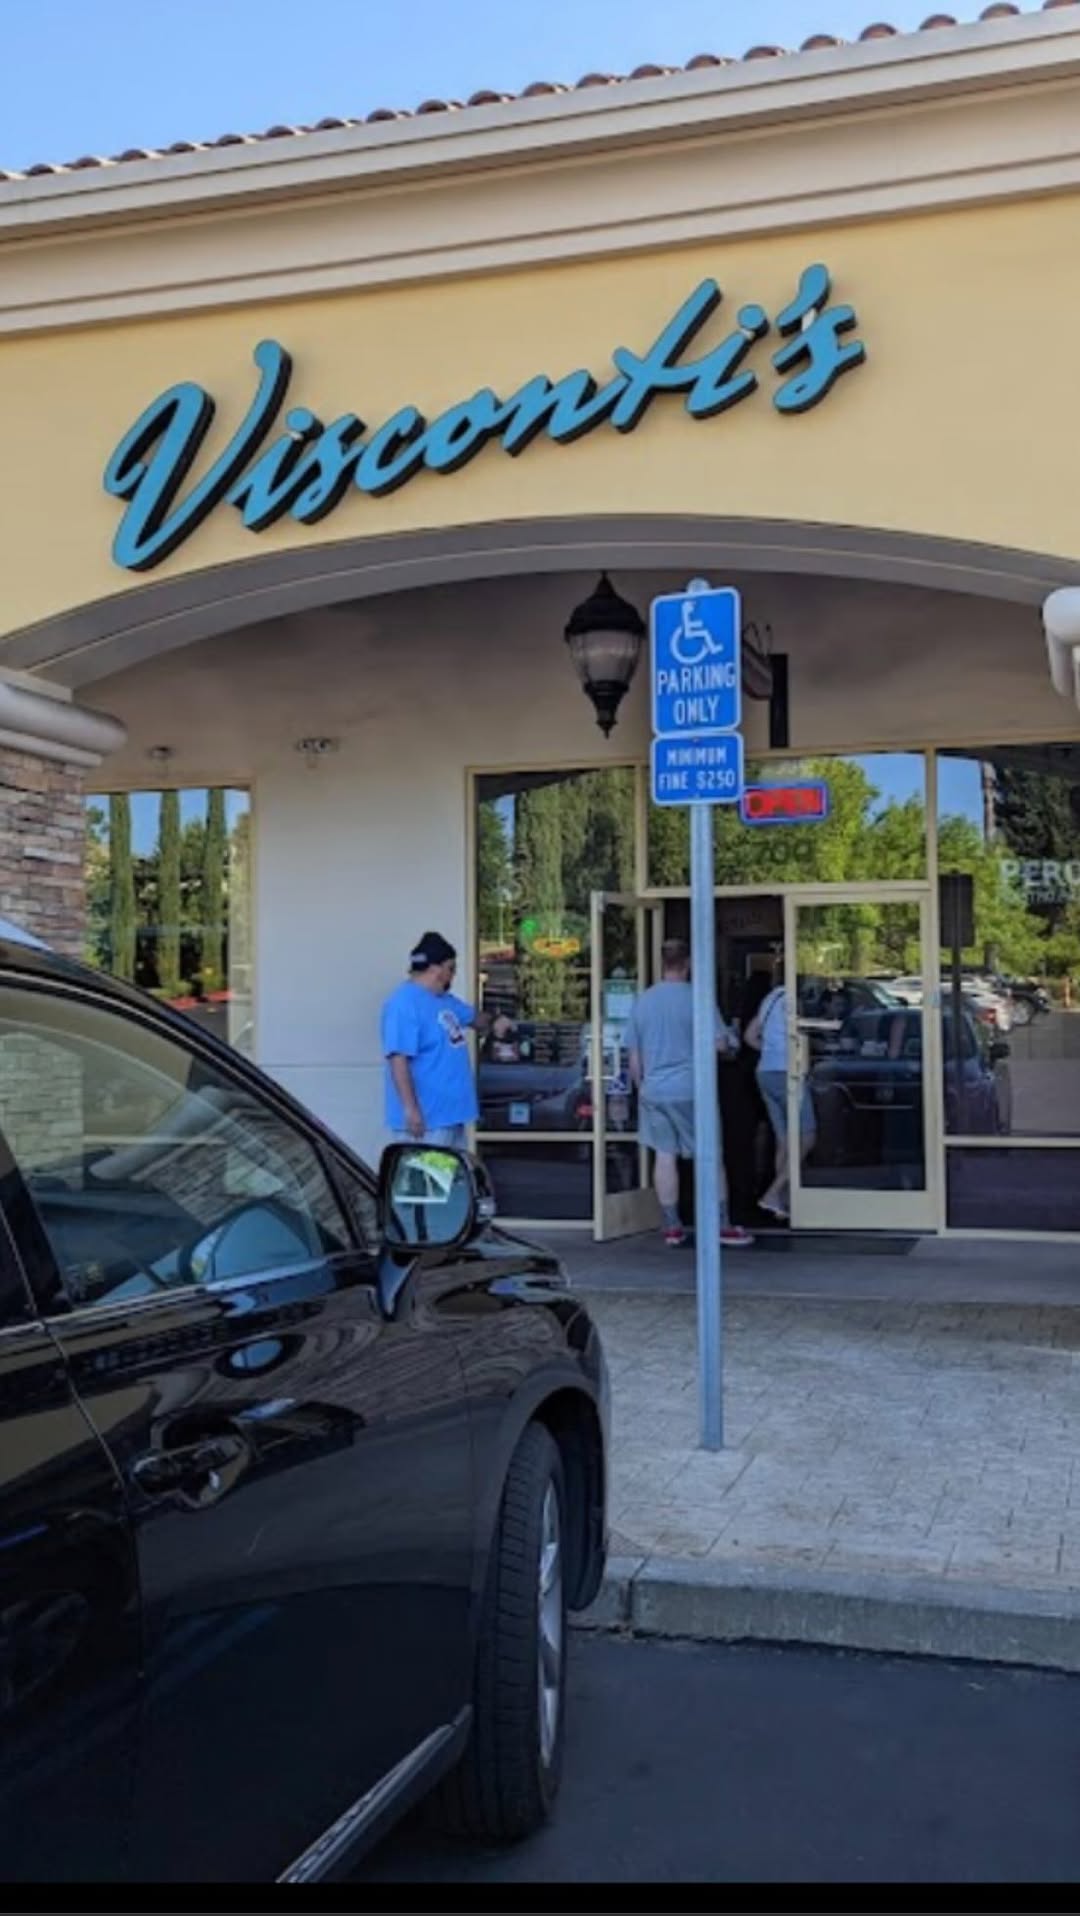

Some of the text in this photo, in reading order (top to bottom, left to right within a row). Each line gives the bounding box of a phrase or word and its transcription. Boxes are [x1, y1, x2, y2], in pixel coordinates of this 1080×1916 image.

[103, 262, 864, 572] Visconti's
[657, 663, 736, 696] PARKING
[673, 695, 721, 726] ONLY
[666, 746, 727, 767] MINIMUM
[658, 769, 736, 791] FINE $250
